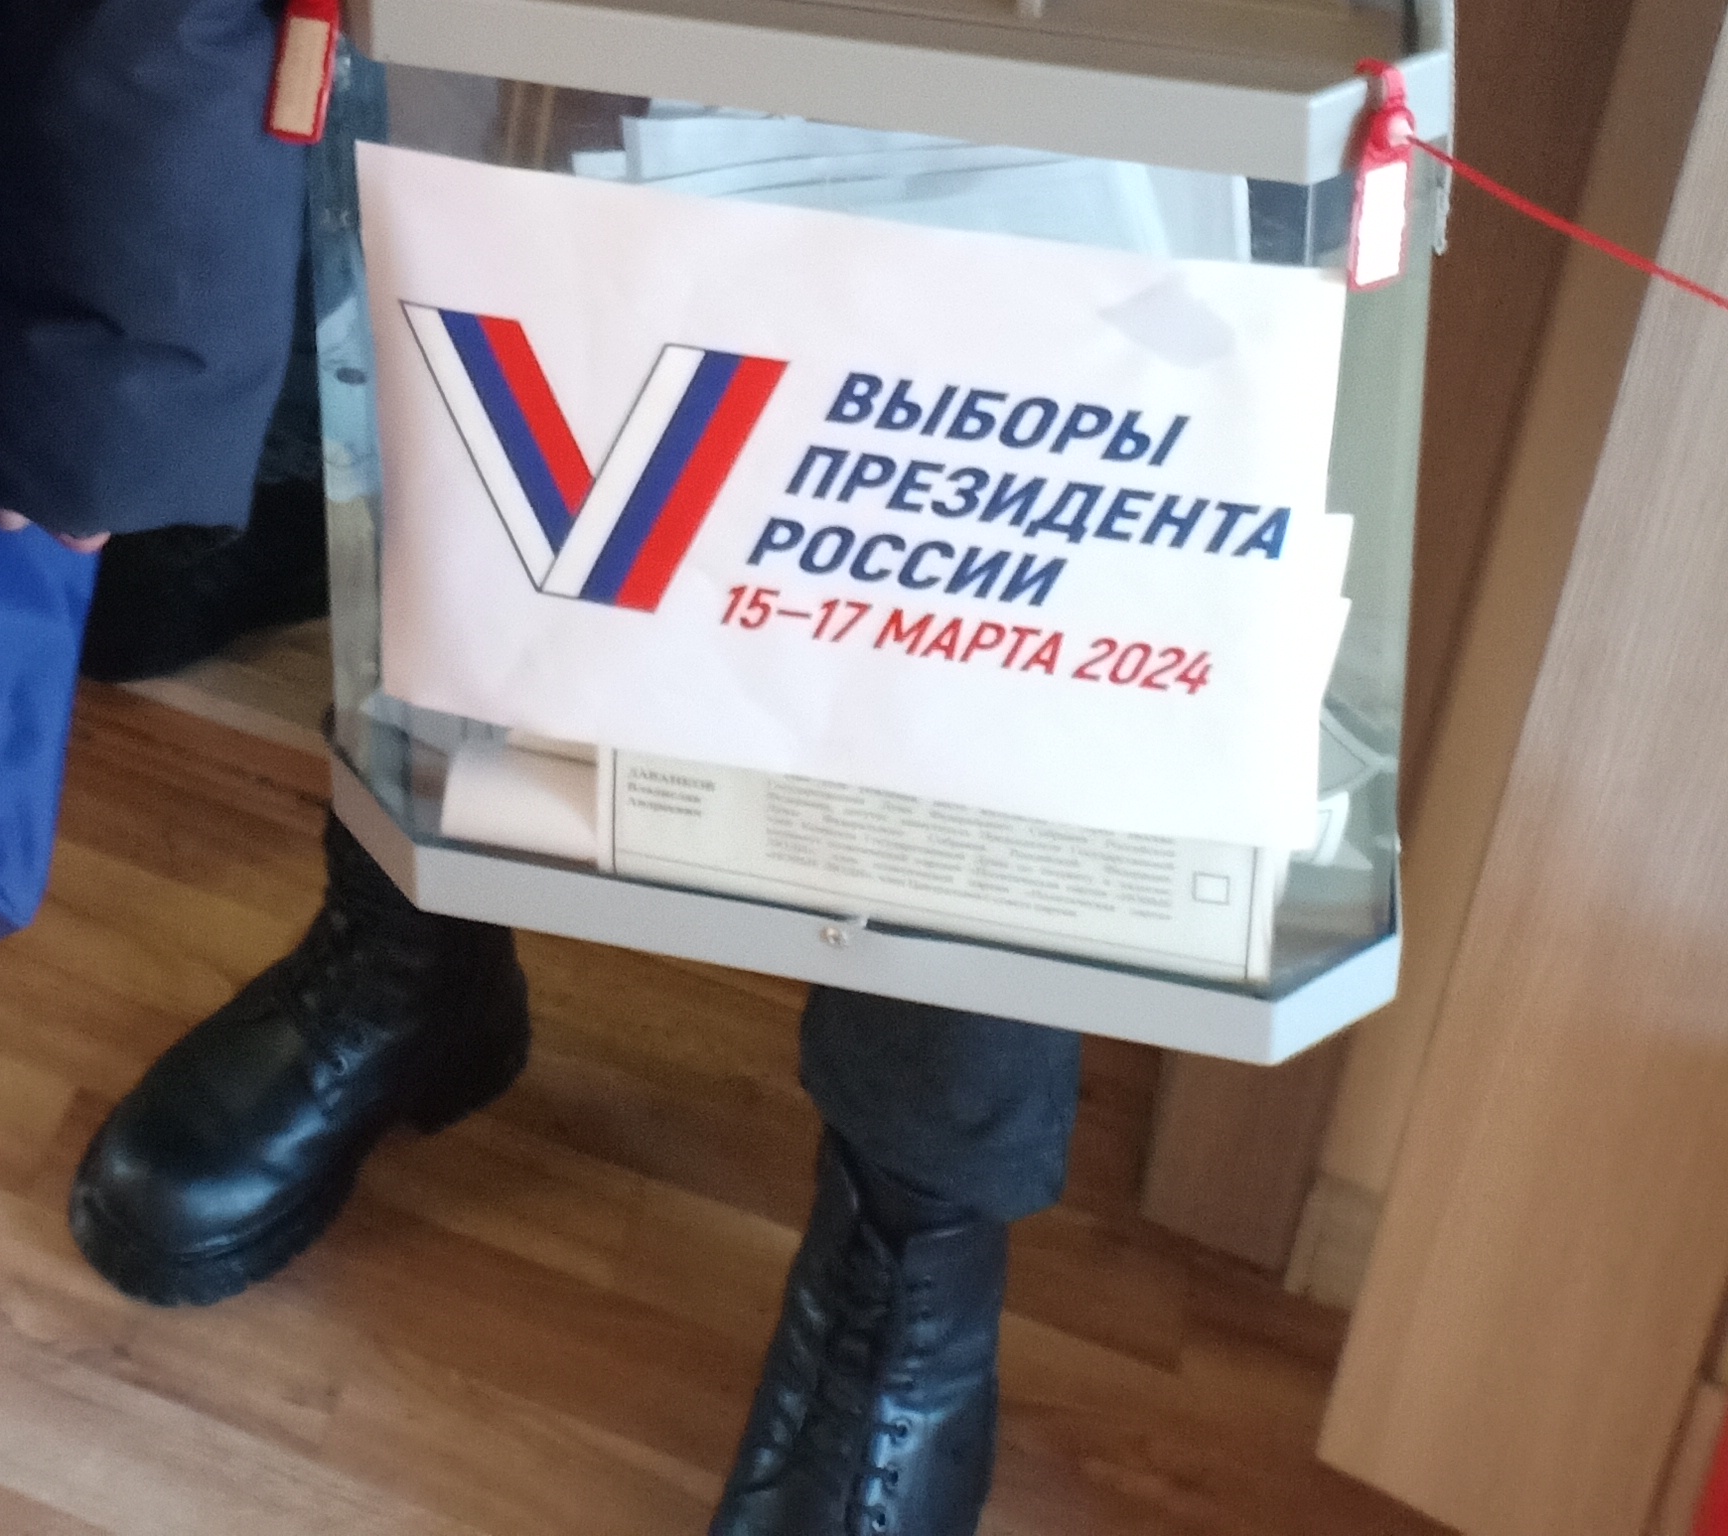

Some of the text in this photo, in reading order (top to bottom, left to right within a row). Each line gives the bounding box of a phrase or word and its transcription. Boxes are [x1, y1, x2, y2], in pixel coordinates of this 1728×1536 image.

[824, 370, 1190, 468] ВЫБОРЫ
[784, 444, 1292, 560] ПРЕЗИДЕНТА
[746, 516, 1068, 608] РОССИИ
[874, 607, 1066, 675] МАРТА
[1073, 636, 1213, 696] 2024
